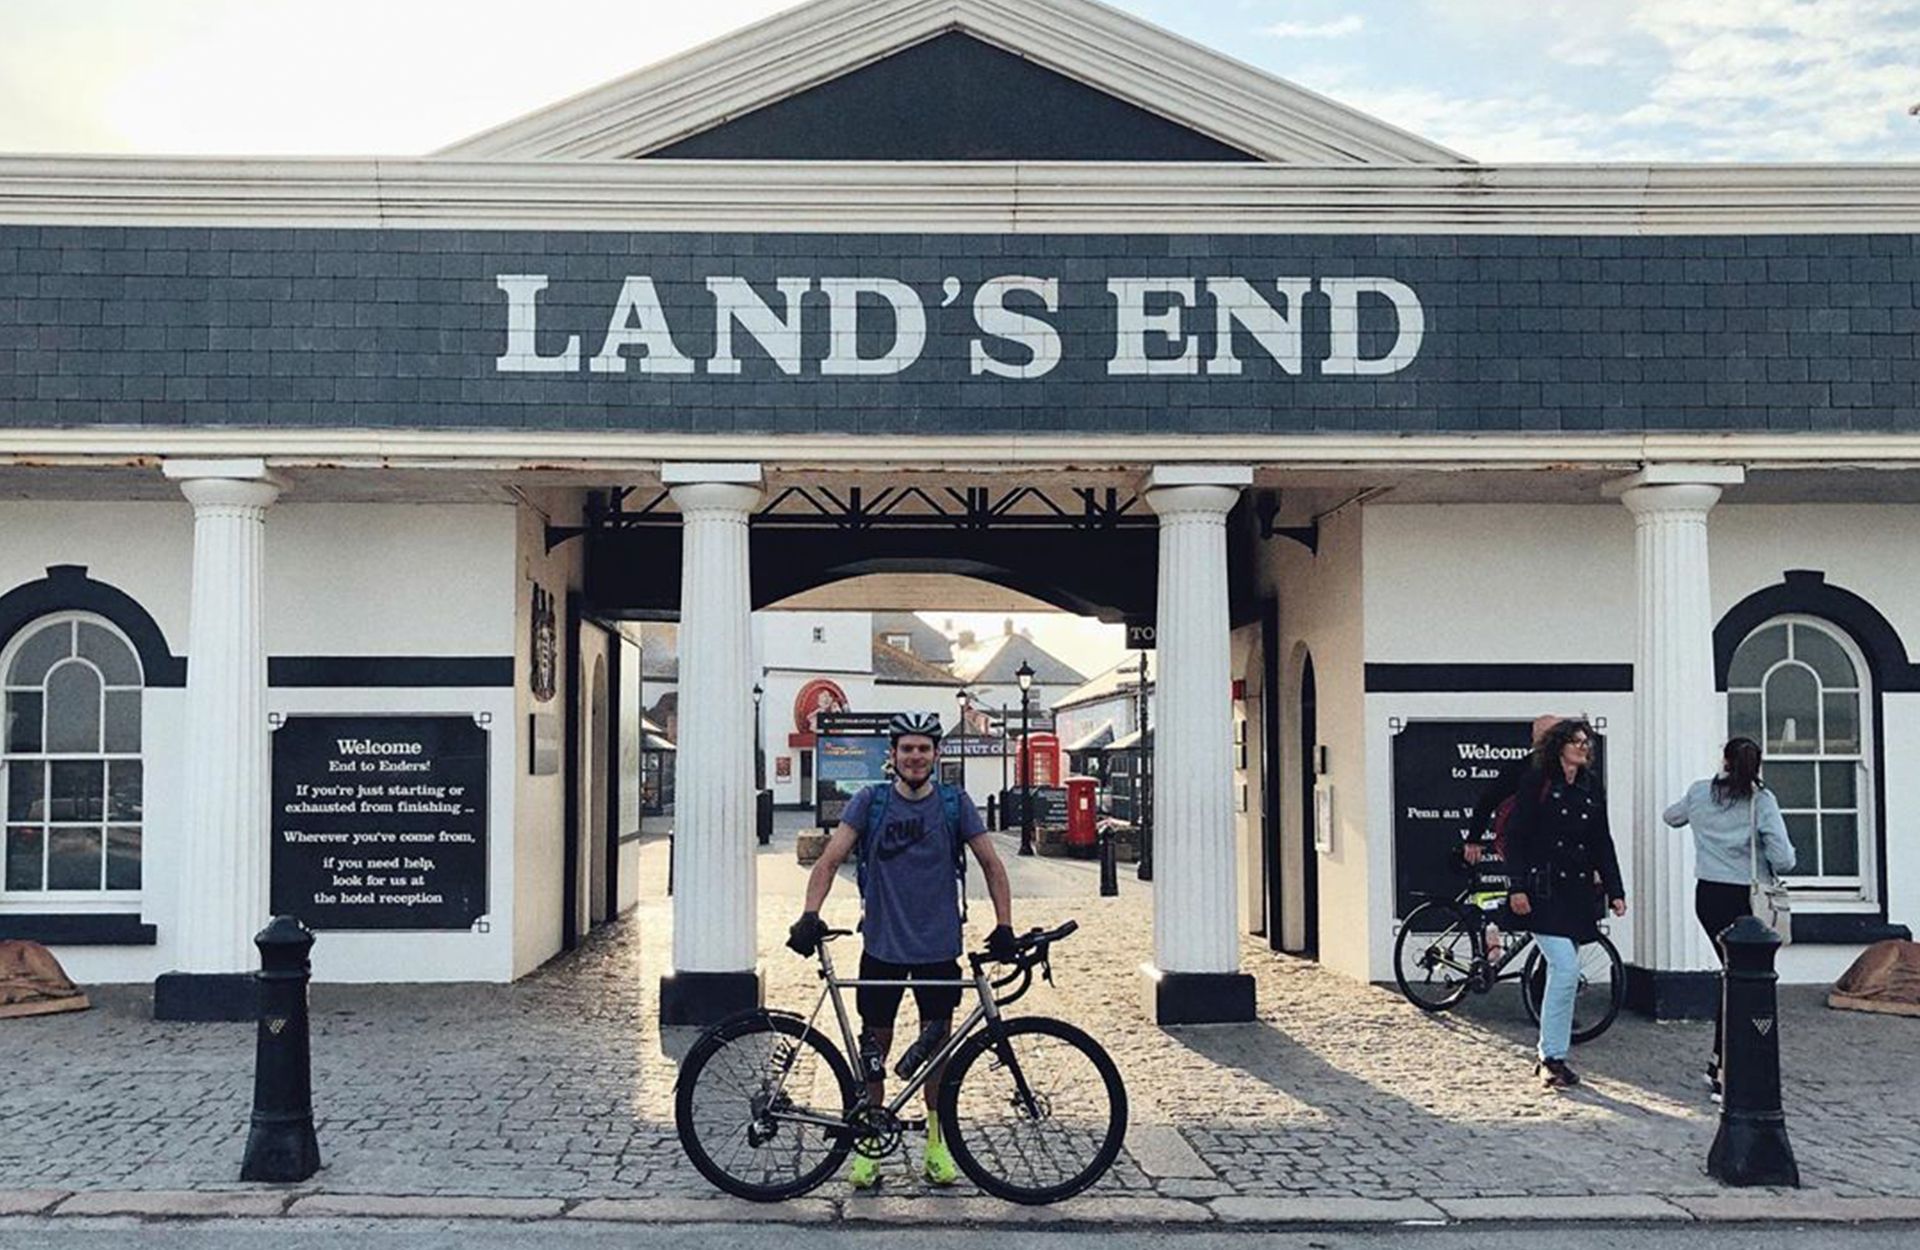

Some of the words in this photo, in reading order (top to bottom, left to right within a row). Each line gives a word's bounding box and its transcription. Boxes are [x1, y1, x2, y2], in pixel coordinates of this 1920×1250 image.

[495, 274, 1062, 379] LAND'S
[1107, 276, 1425, 376] END
[336, 738, 422, 756] Welcome
[1457, 743, 1536, 760] Welcom
[328, 760, 357, 772] End
[360, 761, 376, 772] to
[378, 759, 431, 772] Enders!
[1451, 766, 1467, 779] to
[1470, 766, 1500, 779] Lan
[296, 784, 310, 796] If
[311, 784, 355, 799] you're
[356, 784, 385, 799] just
[387, 784, 446, 799] starting
[448, 786, 465, 796] or
[284, 801, 357, 813] exhausted
[360, 800, 394, 813] from
[397, 800, 462, 815] finishing
[1407, 807, 1440, 819] Penn
[1442, 809, 1461, 819] an
[283, 830, 350, 843] Wherever
[352, 831, 397, 845] you've
[399, 833, 436, 843] come
[438, 830, 476, 843] from,
[323, 856, 335, 869] if
[337, 859, 363, 872] you
[367, 857, 400, 869] need
[403, 856, 436, 872] help,
[332, 874, 363, 887] look
[366, 874, 387, 886] for
[389, 877, 407, 886] us
[410, 875, 425, 886] at
[313, 892, 337, 904] the
[340, 892, 375, 904] hotel
[379, 892, 443, 907] reception
